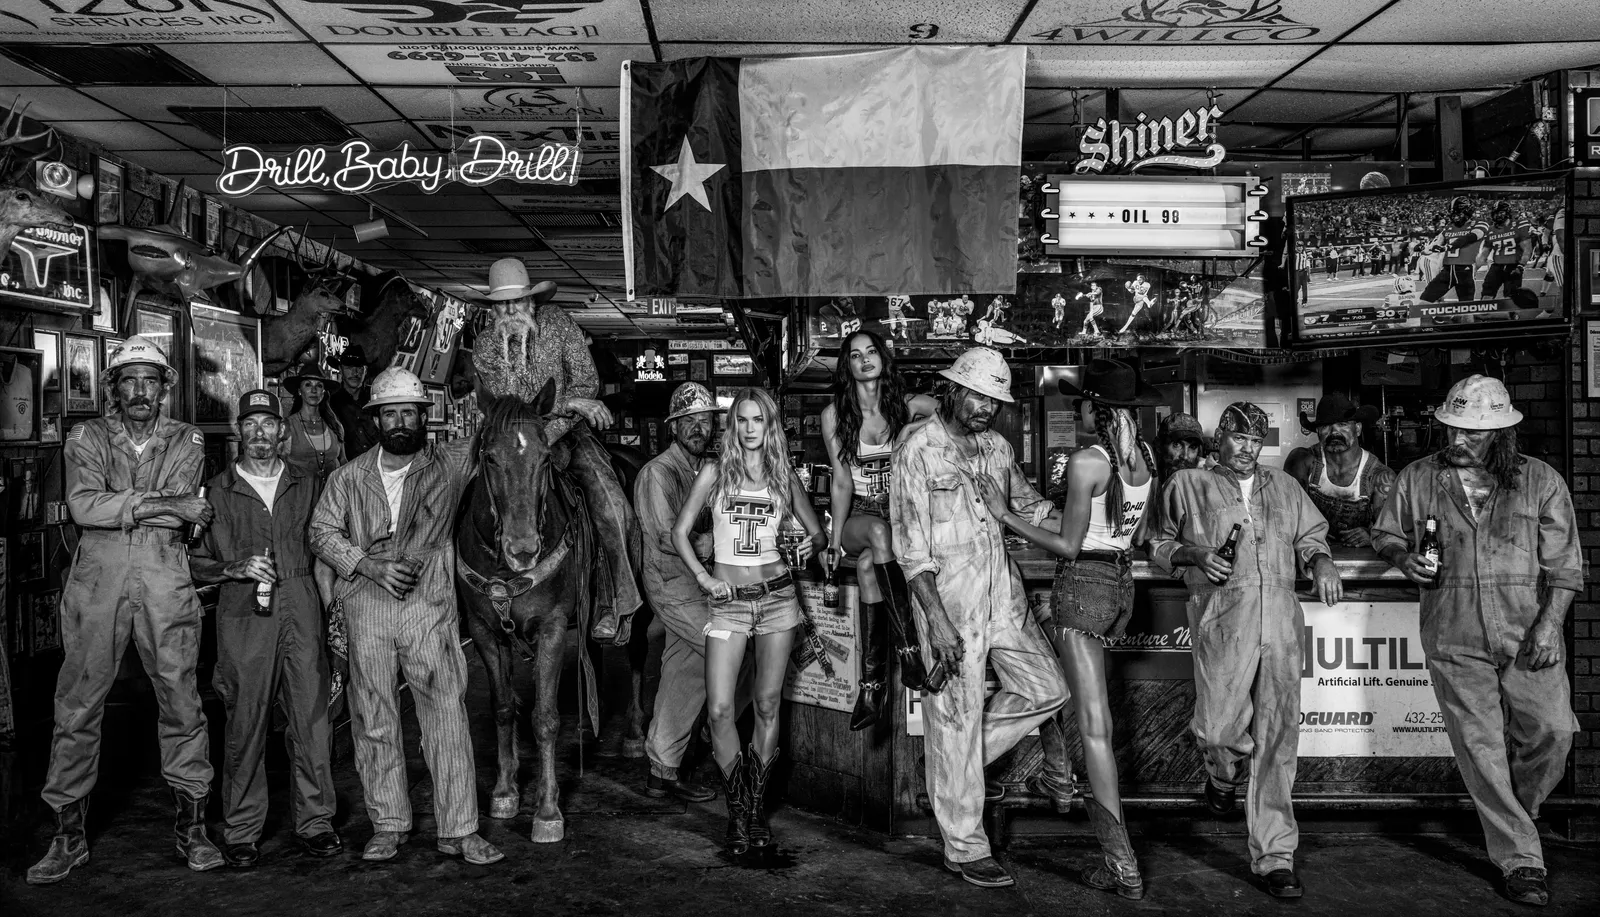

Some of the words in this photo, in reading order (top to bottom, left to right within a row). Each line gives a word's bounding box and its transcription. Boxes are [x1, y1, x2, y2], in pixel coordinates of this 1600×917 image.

[50, 15, 204, 27] SERVICES
[210, 14, 273, 26] INC.
[325, 25, 495, 37] DOUBLE
[1030, 26, 1321, 41] 4WILLCO
[1075, 104, 1224, 173] Shiner
[219, 146, 331, 194] Drill,
[333, 140, 452, 192] Baby,
[460, 135, 579, 185] Drill!
[1122, 209, 1149, 223] OIL
[1162, 209, 1180, 223] 98
[1492, 237, 1517, 255] 72
[652, 298, 672, 315] EXIT
[890, 297, 905, 307] 67
[1320, 314, 1330, 322] 7
[1376, 309, 1396, 317] 30
[1420, 303, 1498, 315] TOUCHDOWN
[638, 369, 664, 380] Modelo
[1123, 501, 1145, 512] Drill
[1317, 677, 1361, 687] Artificial
[1363, 677, 1383, 687] Lift.
[1386, 677, 1428, 687] Genuine
